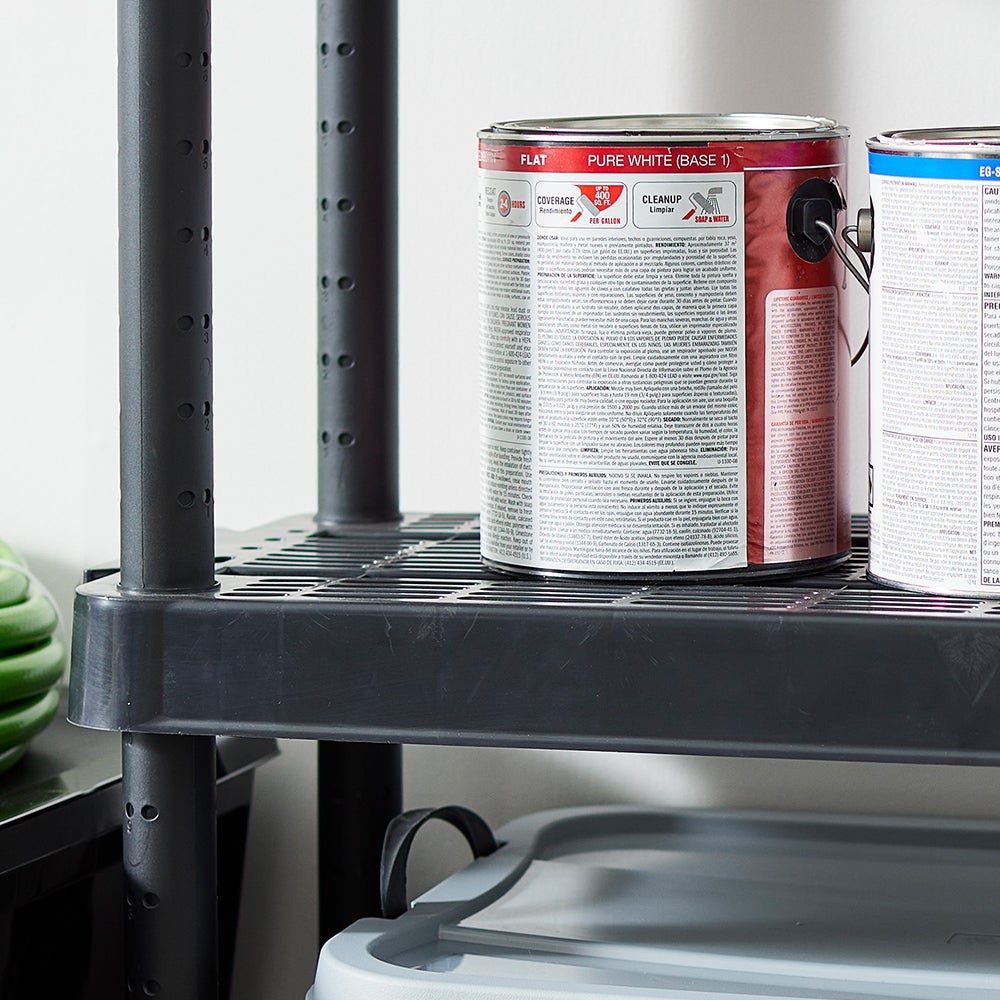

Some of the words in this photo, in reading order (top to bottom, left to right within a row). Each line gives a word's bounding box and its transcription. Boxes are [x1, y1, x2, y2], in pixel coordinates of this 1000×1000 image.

[521, 154, 546, 165] FLAT
[588, 155, 624, 166] PURE
[628, 155, 672, 166] WHITE
[676, 154, 716, 168] (BASE
[720, 154, 730, 168] 1)
[596, 191, 610, 199] 400
[642, 195, 682, 204] CLEANUP
[538, 196, 574, 206] COVERAGE
